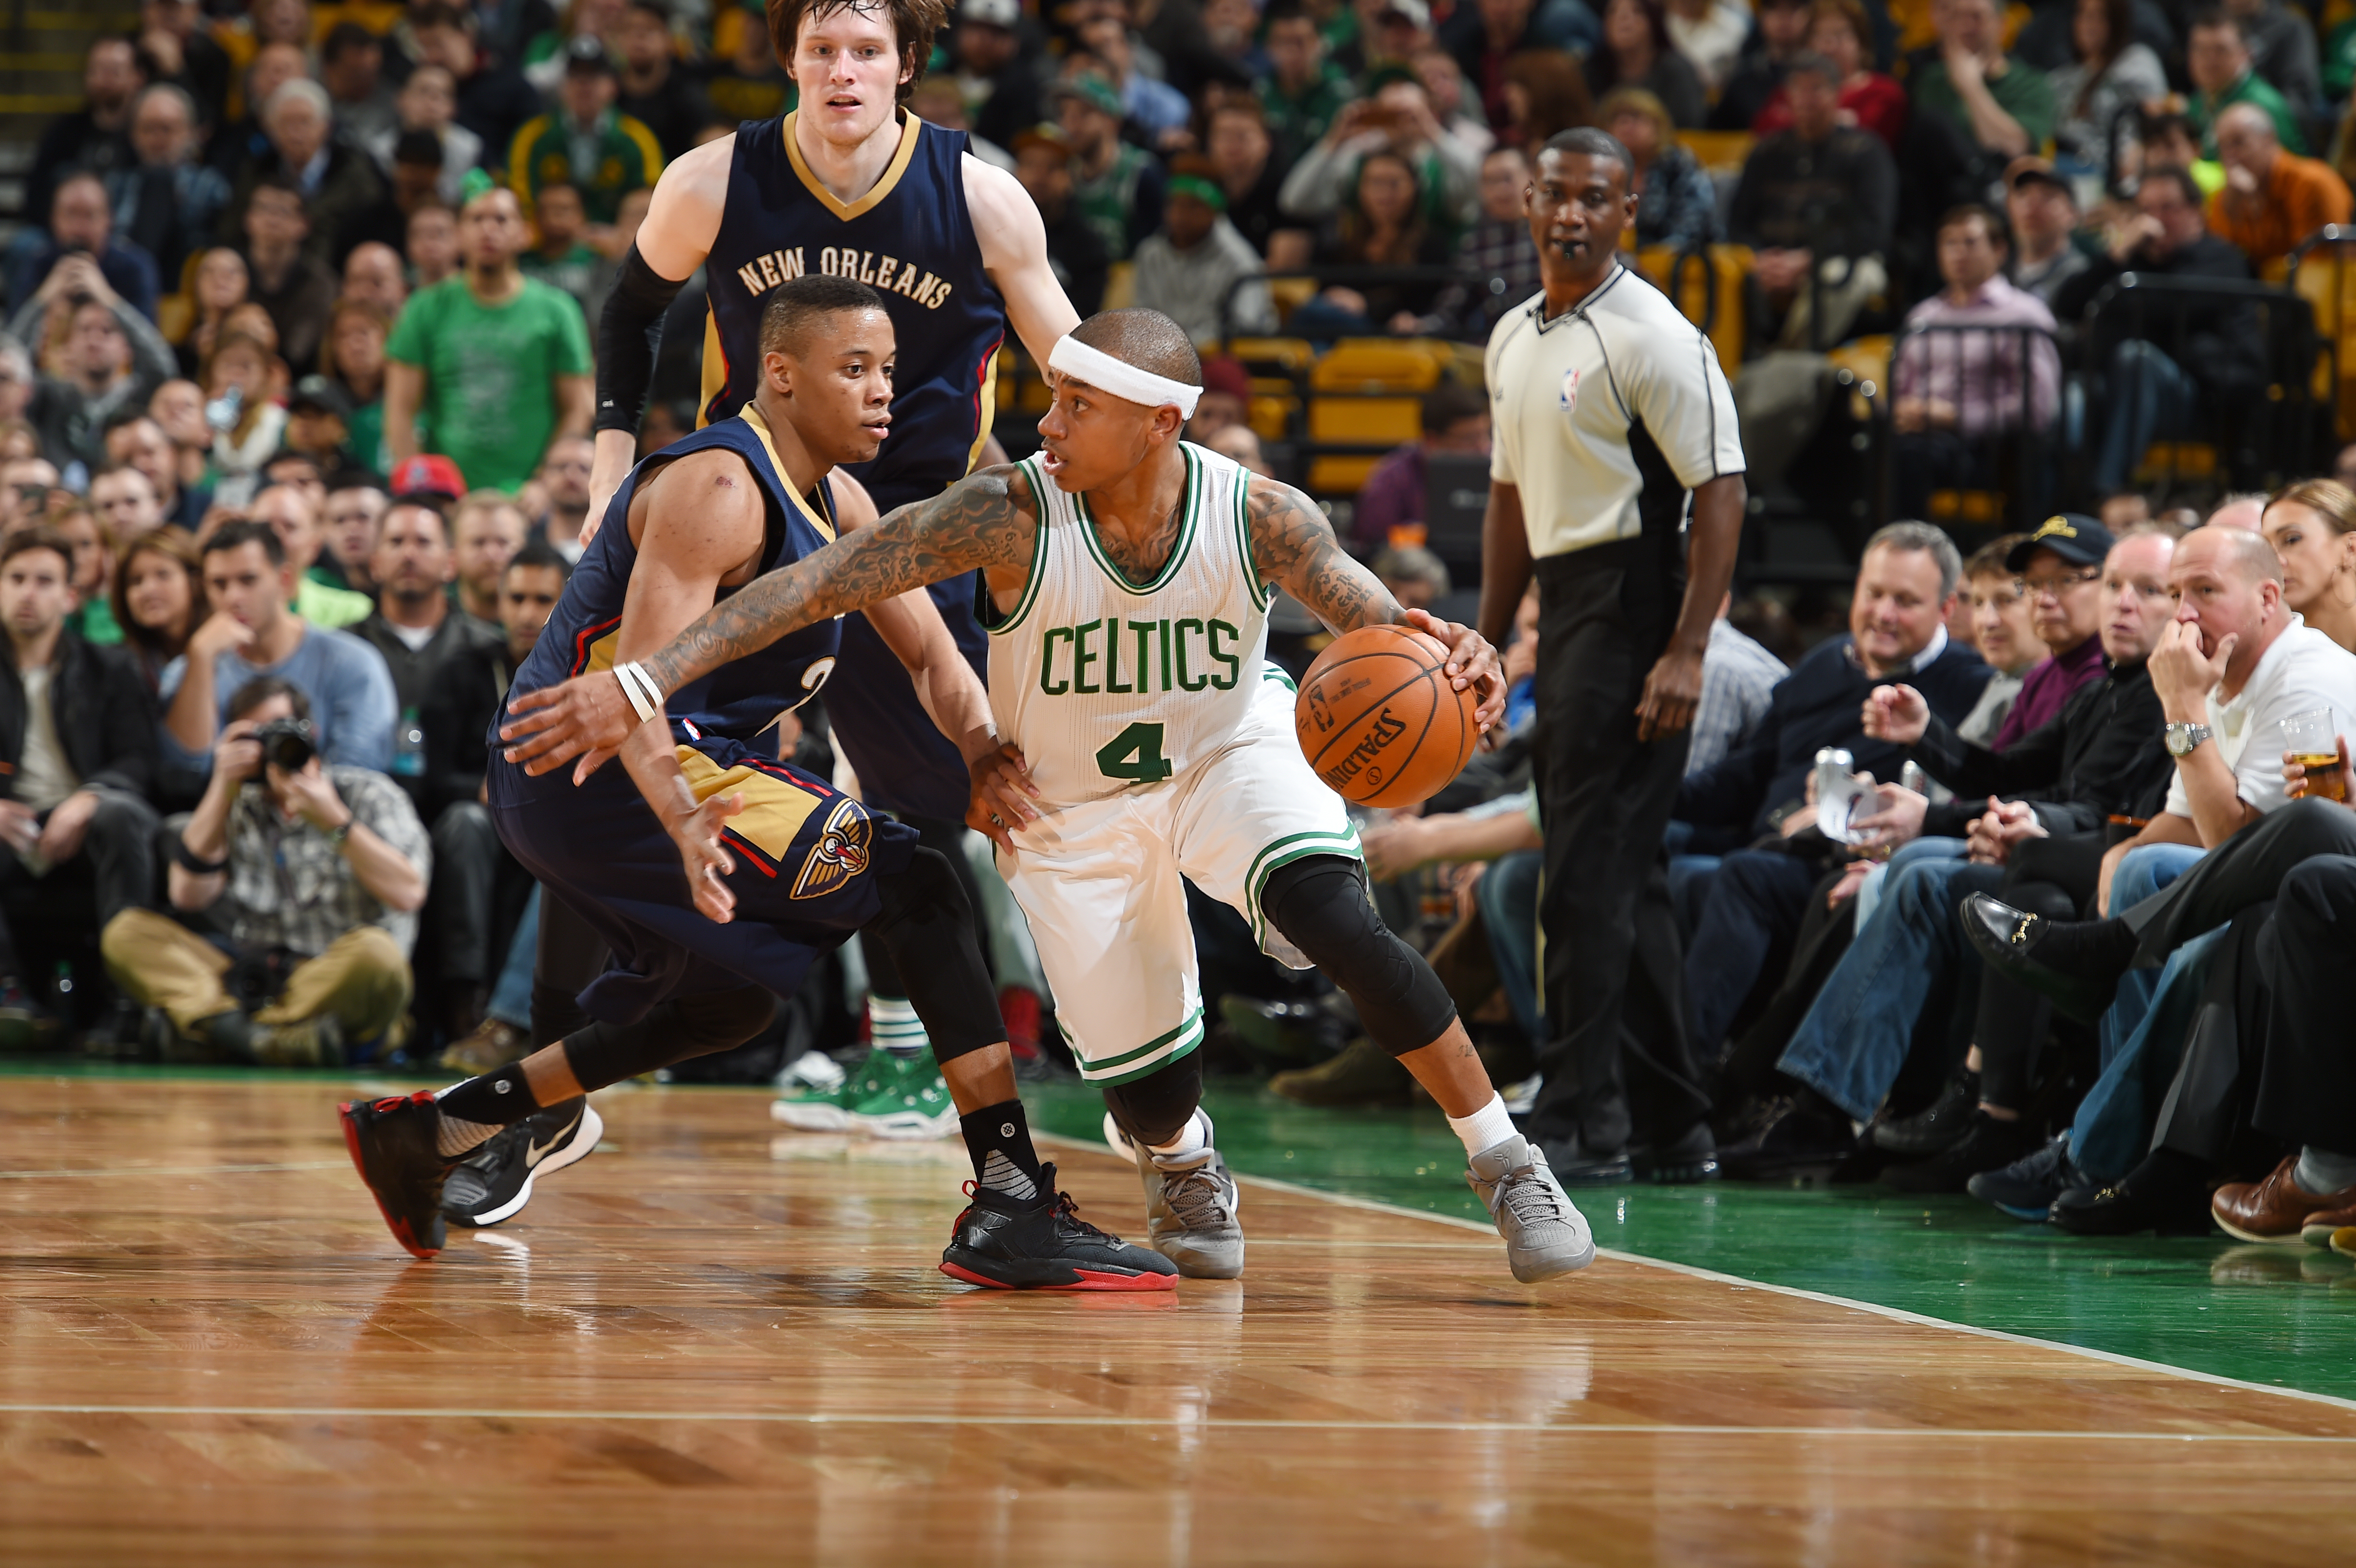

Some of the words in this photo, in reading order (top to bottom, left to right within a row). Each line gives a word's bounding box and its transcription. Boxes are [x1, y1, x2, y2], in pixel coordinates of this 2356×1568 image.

[737, 246, 806, 297] NEW
[820, 246, 952, 309] ORLEANS
[1040, 618, 1239, 696] CELTICS
[1095, 721, 1173, 784] 4
[1320, 708, 1406, 793] SPALDIN
